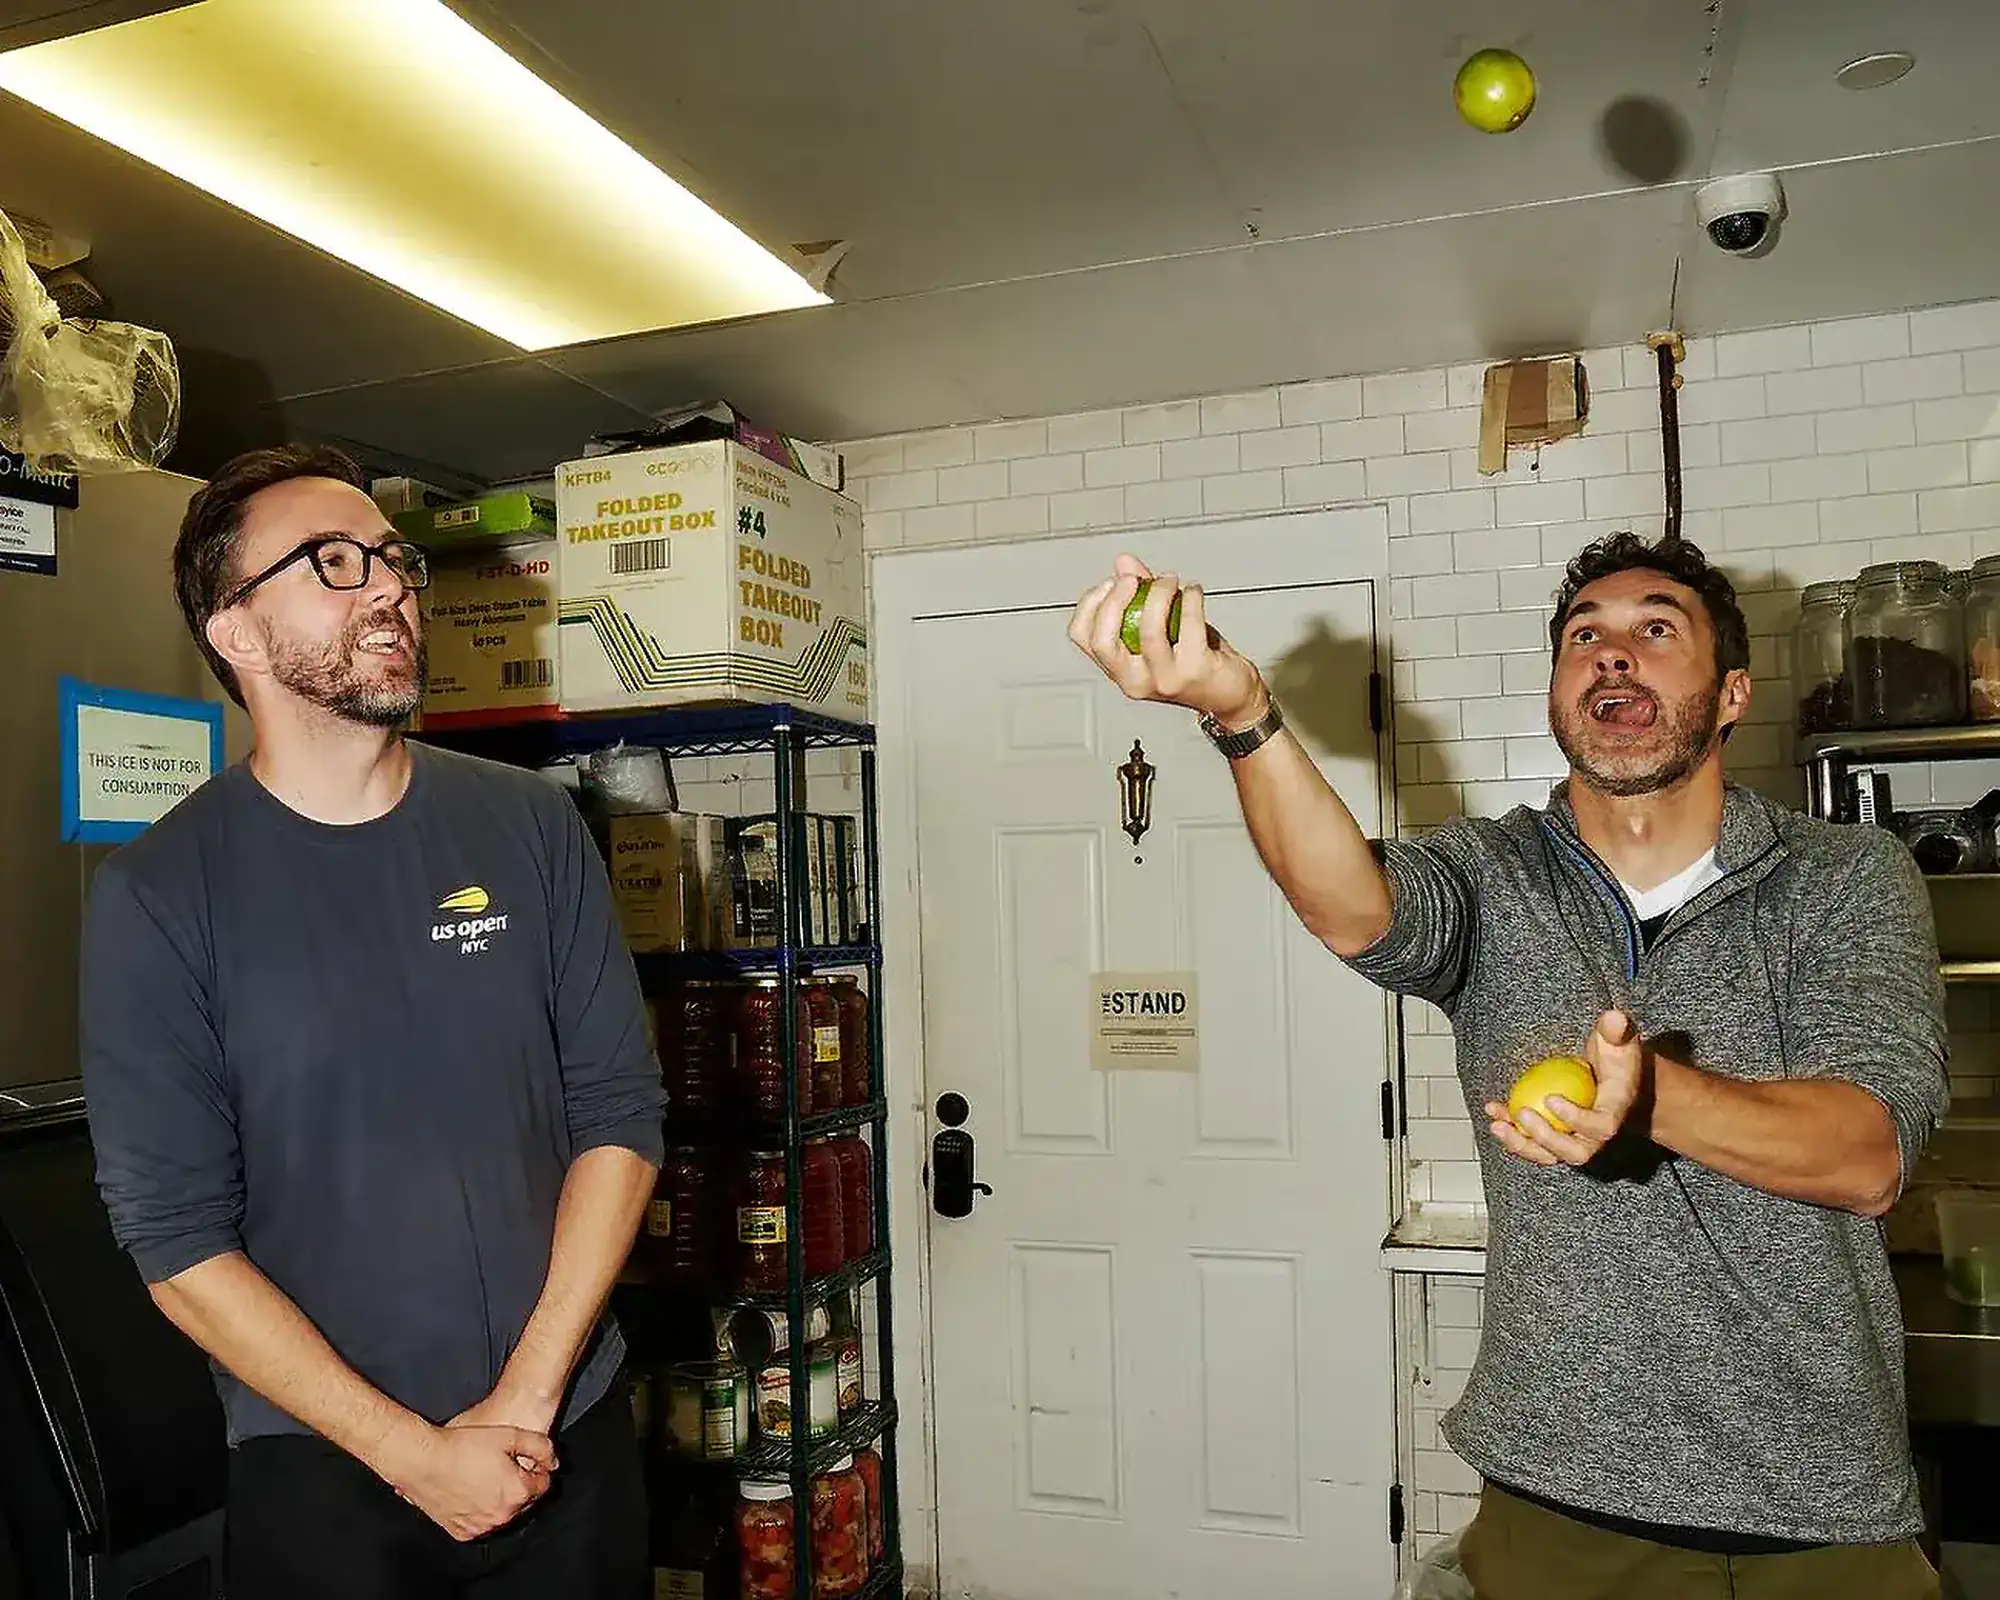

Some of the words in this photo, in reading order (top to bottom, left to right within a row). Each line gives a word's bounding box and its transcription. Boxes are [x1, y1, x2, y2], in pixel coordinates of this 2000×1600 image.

[596, 493, 682, 518] FOLDED
[566, 516, 664, 545] TAKEOUT
[669, 509, 716, 531] BOX
[738, 505, 766, 539] #4
[738, 544, 811, 589] FOLDED
[738, 580, 822, 627] TAKEOUT
[739, 616, 783, 648] BOX
[88, 753, 116, 768] THIS
[118, 755, 137, 769] ICE
[139, 757, 150, 770] IS
[152, 758, 177, 772] NOT
[179, 759, 202, 773] FOR
[101, 779, 190, 796] CONSUMPTION
[457, 915, 508, 939] open
[461, 939, 489, 954] NYC
[1112, 991, 1187, 1014] STAND
